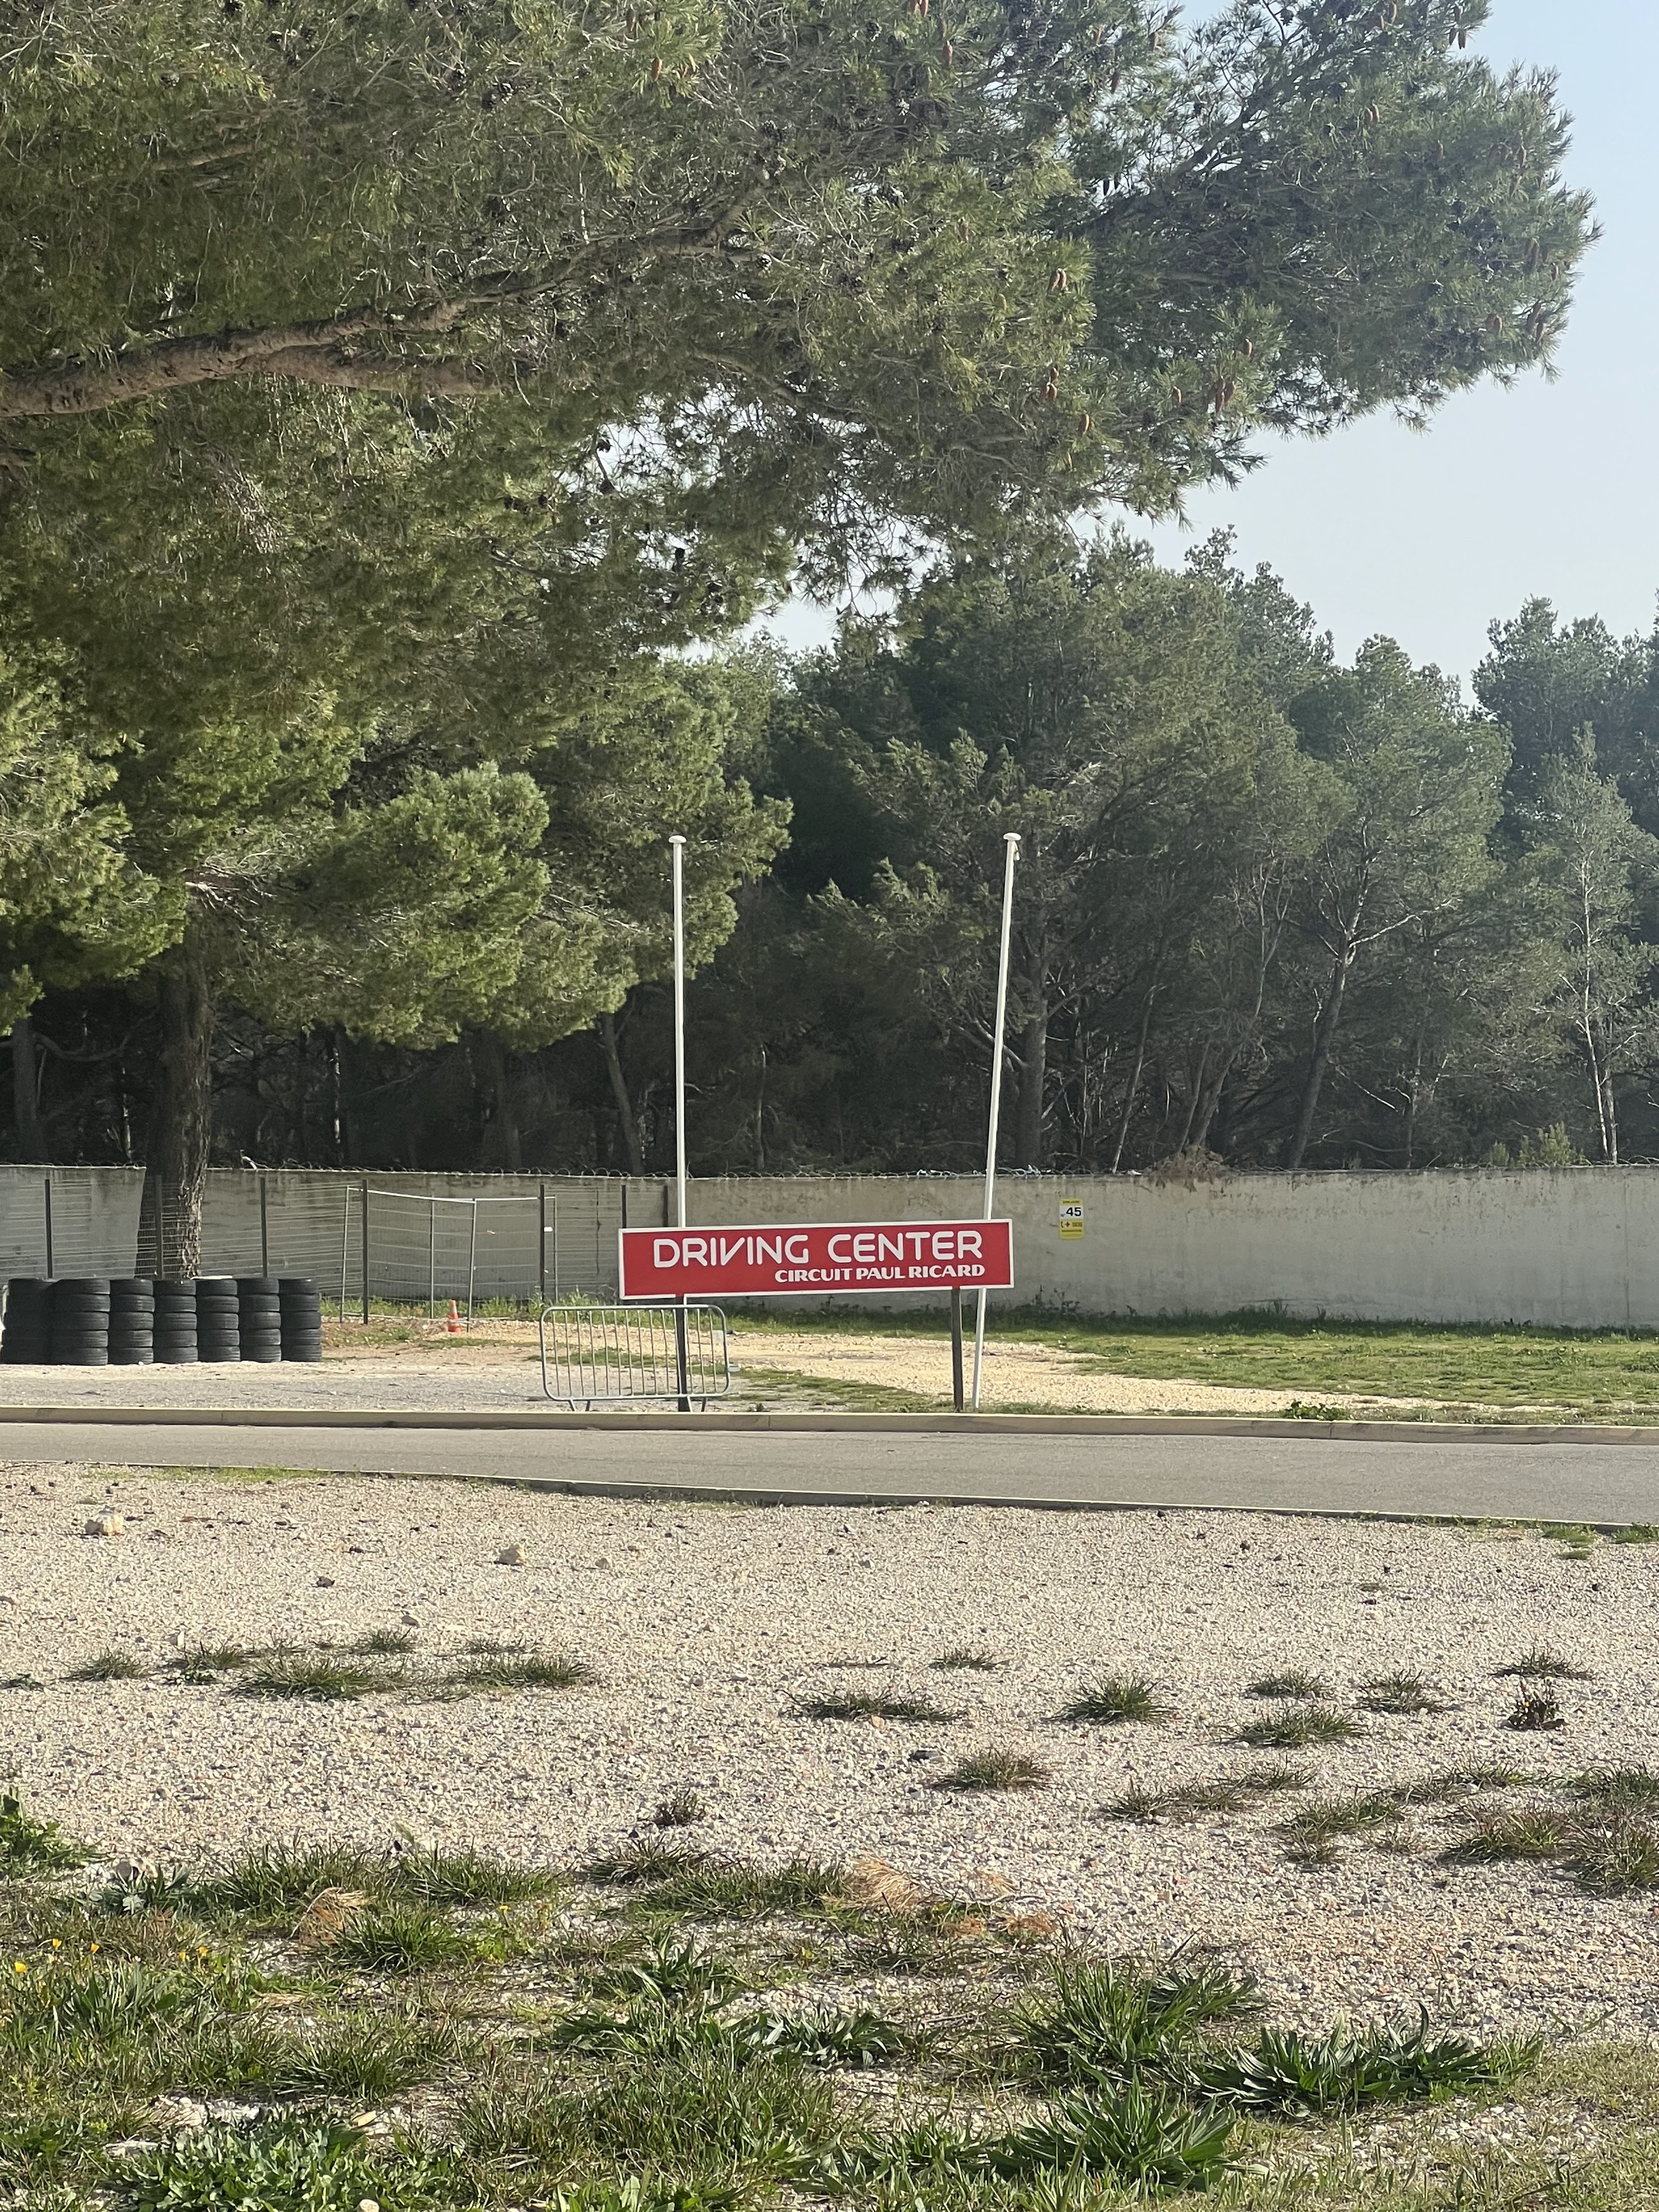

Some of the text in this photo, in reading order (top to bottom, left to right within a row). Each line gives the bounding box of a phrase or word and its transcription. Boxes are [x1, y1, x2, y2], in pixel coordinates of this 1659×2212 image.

[1066, 1207, 1082, 1217] 45
[653, 1231, 983, 1268] DRIVING CENTER
[775, 1265, 985, 1283] CIRCUIT PAUL RICARD
